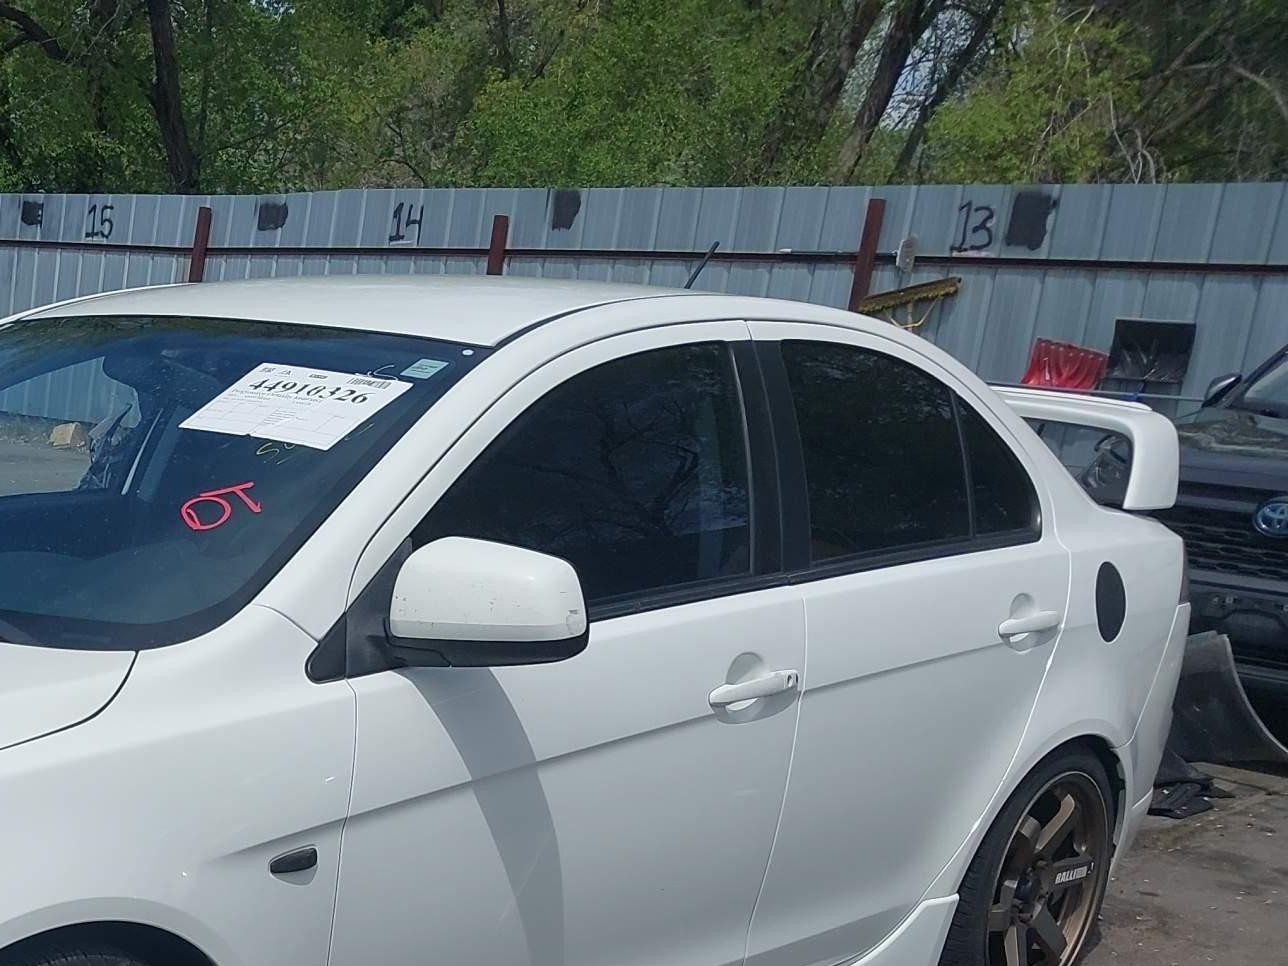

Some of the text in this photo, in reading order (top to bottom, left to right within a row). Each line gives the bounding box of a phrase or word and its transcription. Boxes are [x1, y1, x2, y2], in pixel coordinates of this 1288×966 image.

[85, 203, 114, 238] 15
[388, 202, 424, 247] 14
[950, 200, 994, 253] 13
[249, 379, 373, 404] 44910326
